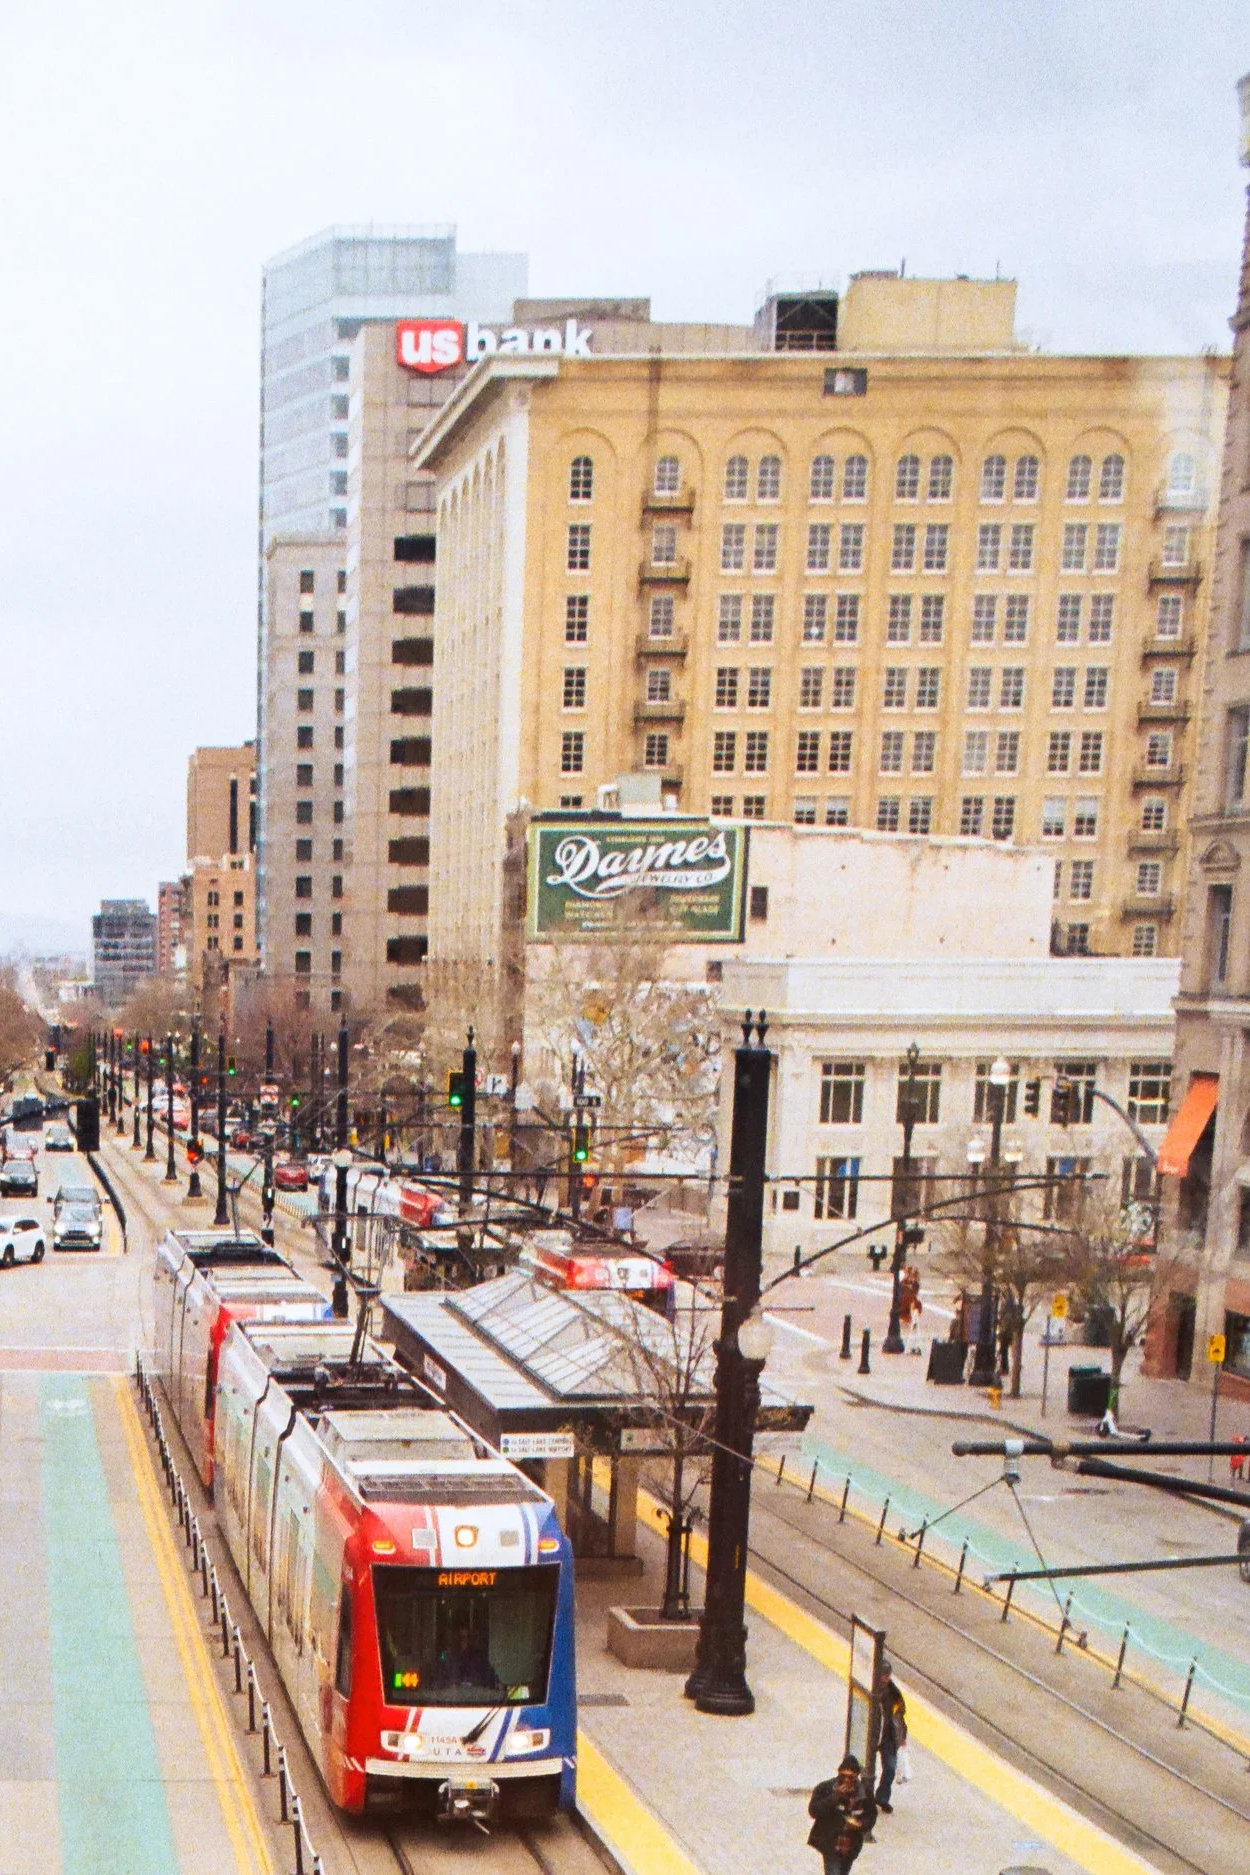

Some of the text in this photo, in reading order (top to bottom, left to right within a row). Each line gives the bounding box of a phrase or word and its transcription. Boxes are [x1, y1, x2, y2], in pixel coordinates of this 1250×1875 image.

[401, 318, 592, 365] us bank
[547, 832, 728, 890] Daynes
[438, 1571, 497, 1586] AIRPORT
